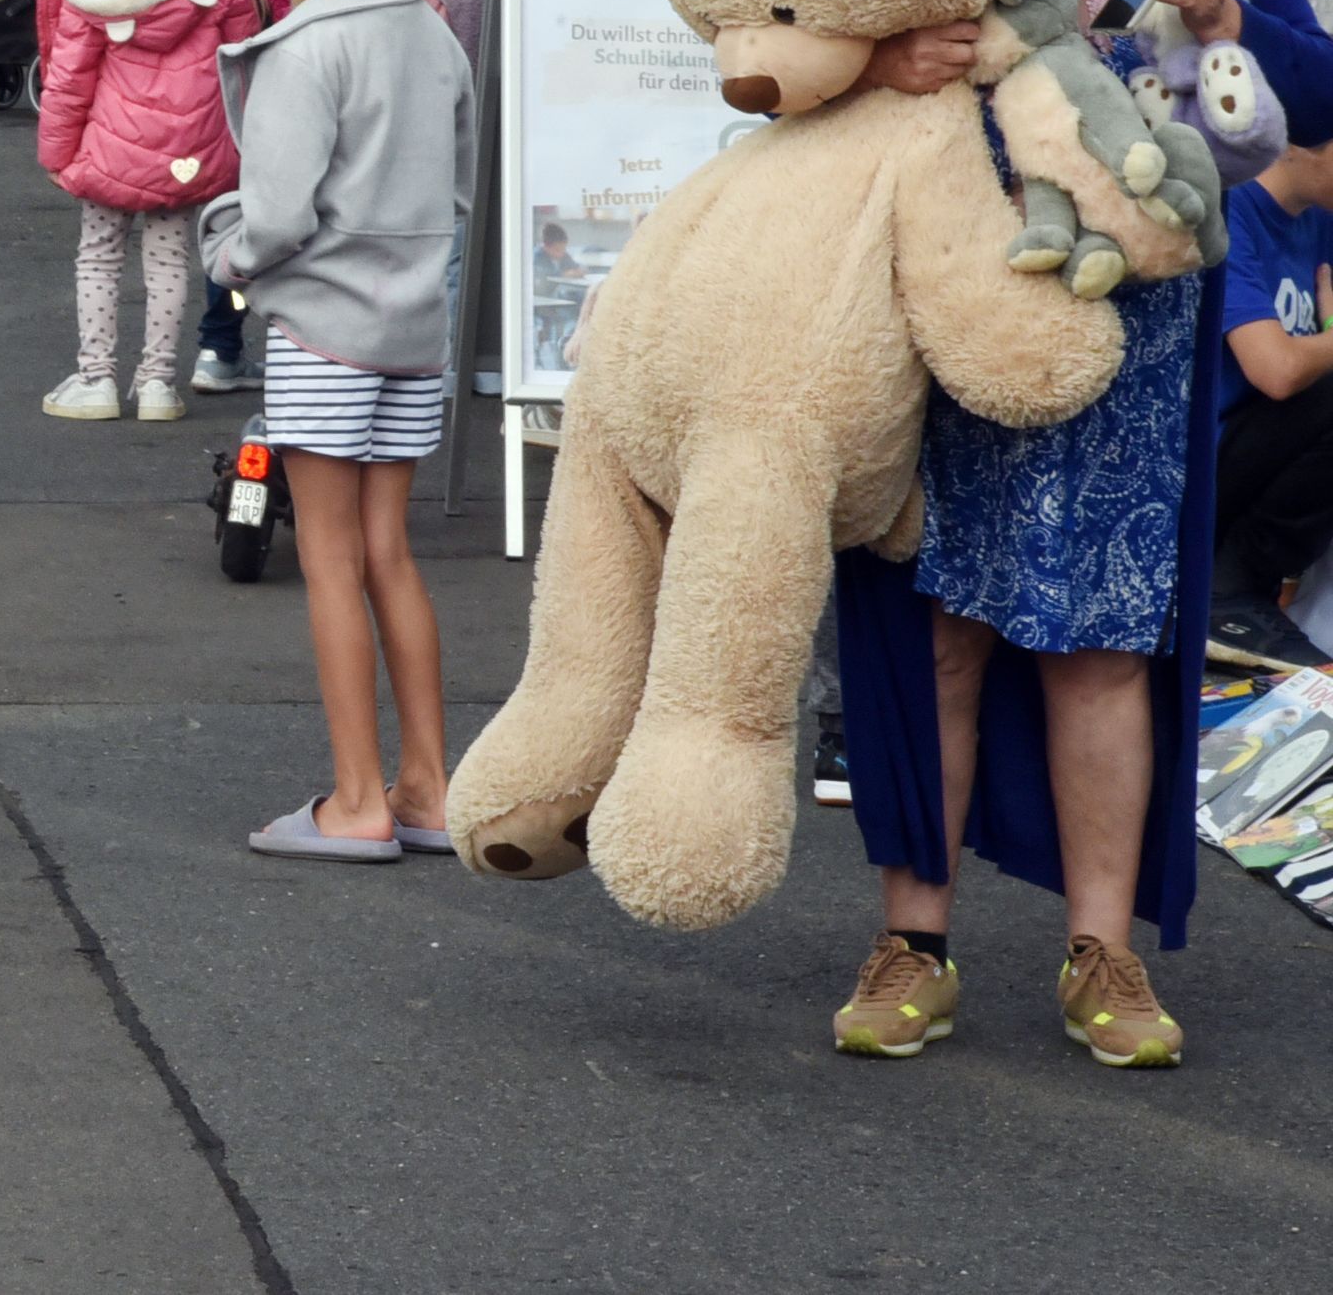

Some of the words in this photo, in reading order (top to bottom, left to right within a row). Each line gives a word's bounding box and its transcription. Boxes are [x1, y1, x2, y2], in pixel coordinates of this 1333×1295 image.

[571, 24, 597, 41] Du
[602, 24, 653, 43] willst
[638, 71, 664, 90] für
[669, 73, 709, 92] dein
[619, 157, 662, 174] Jetzt
